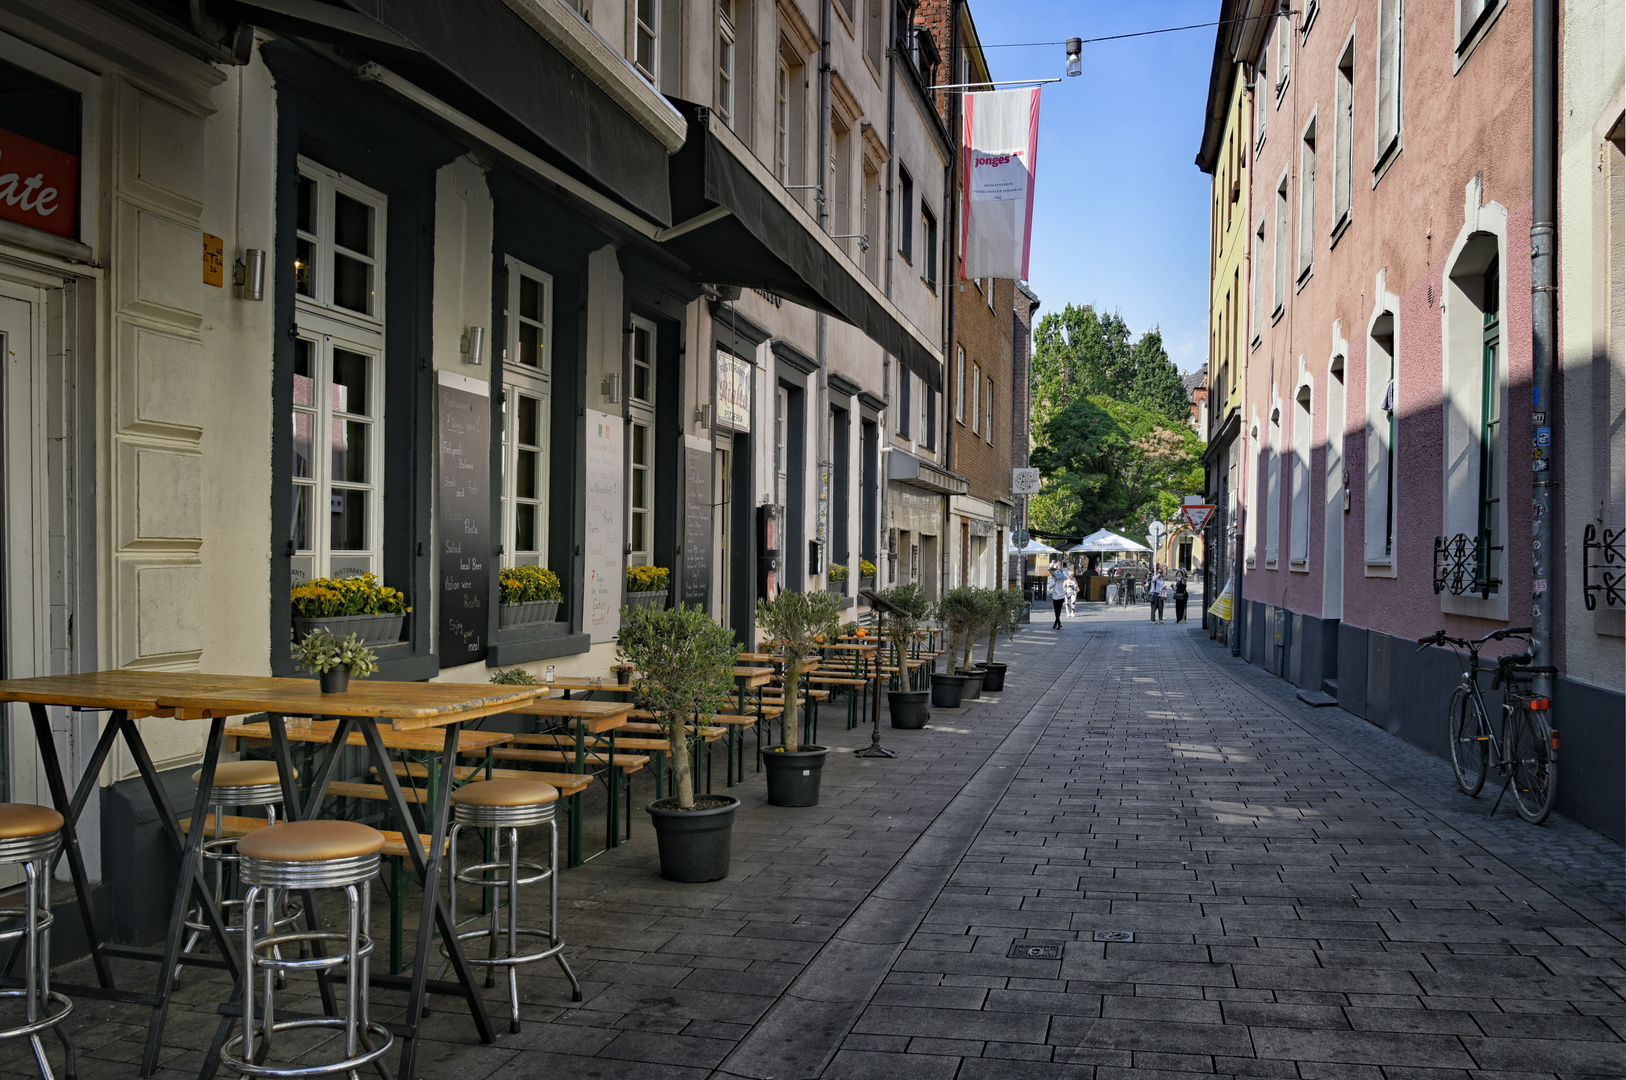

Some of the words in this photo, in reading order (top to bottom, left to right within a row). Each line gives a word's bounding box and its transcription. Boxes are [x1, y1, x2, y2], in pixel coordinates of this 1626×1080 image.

[975, 156, 1010, 168] jonges
[719, 379, 748, 409] Rialto
[464, 519, 478, 534] Pasta
[445, 540, 461, 553] Salad
[471, 557, 483, 571] Beer
[591, 570, 596, 582] 7
[449, 619, 463, 635] Enjoy
[468, 636, 480, 652] meal
